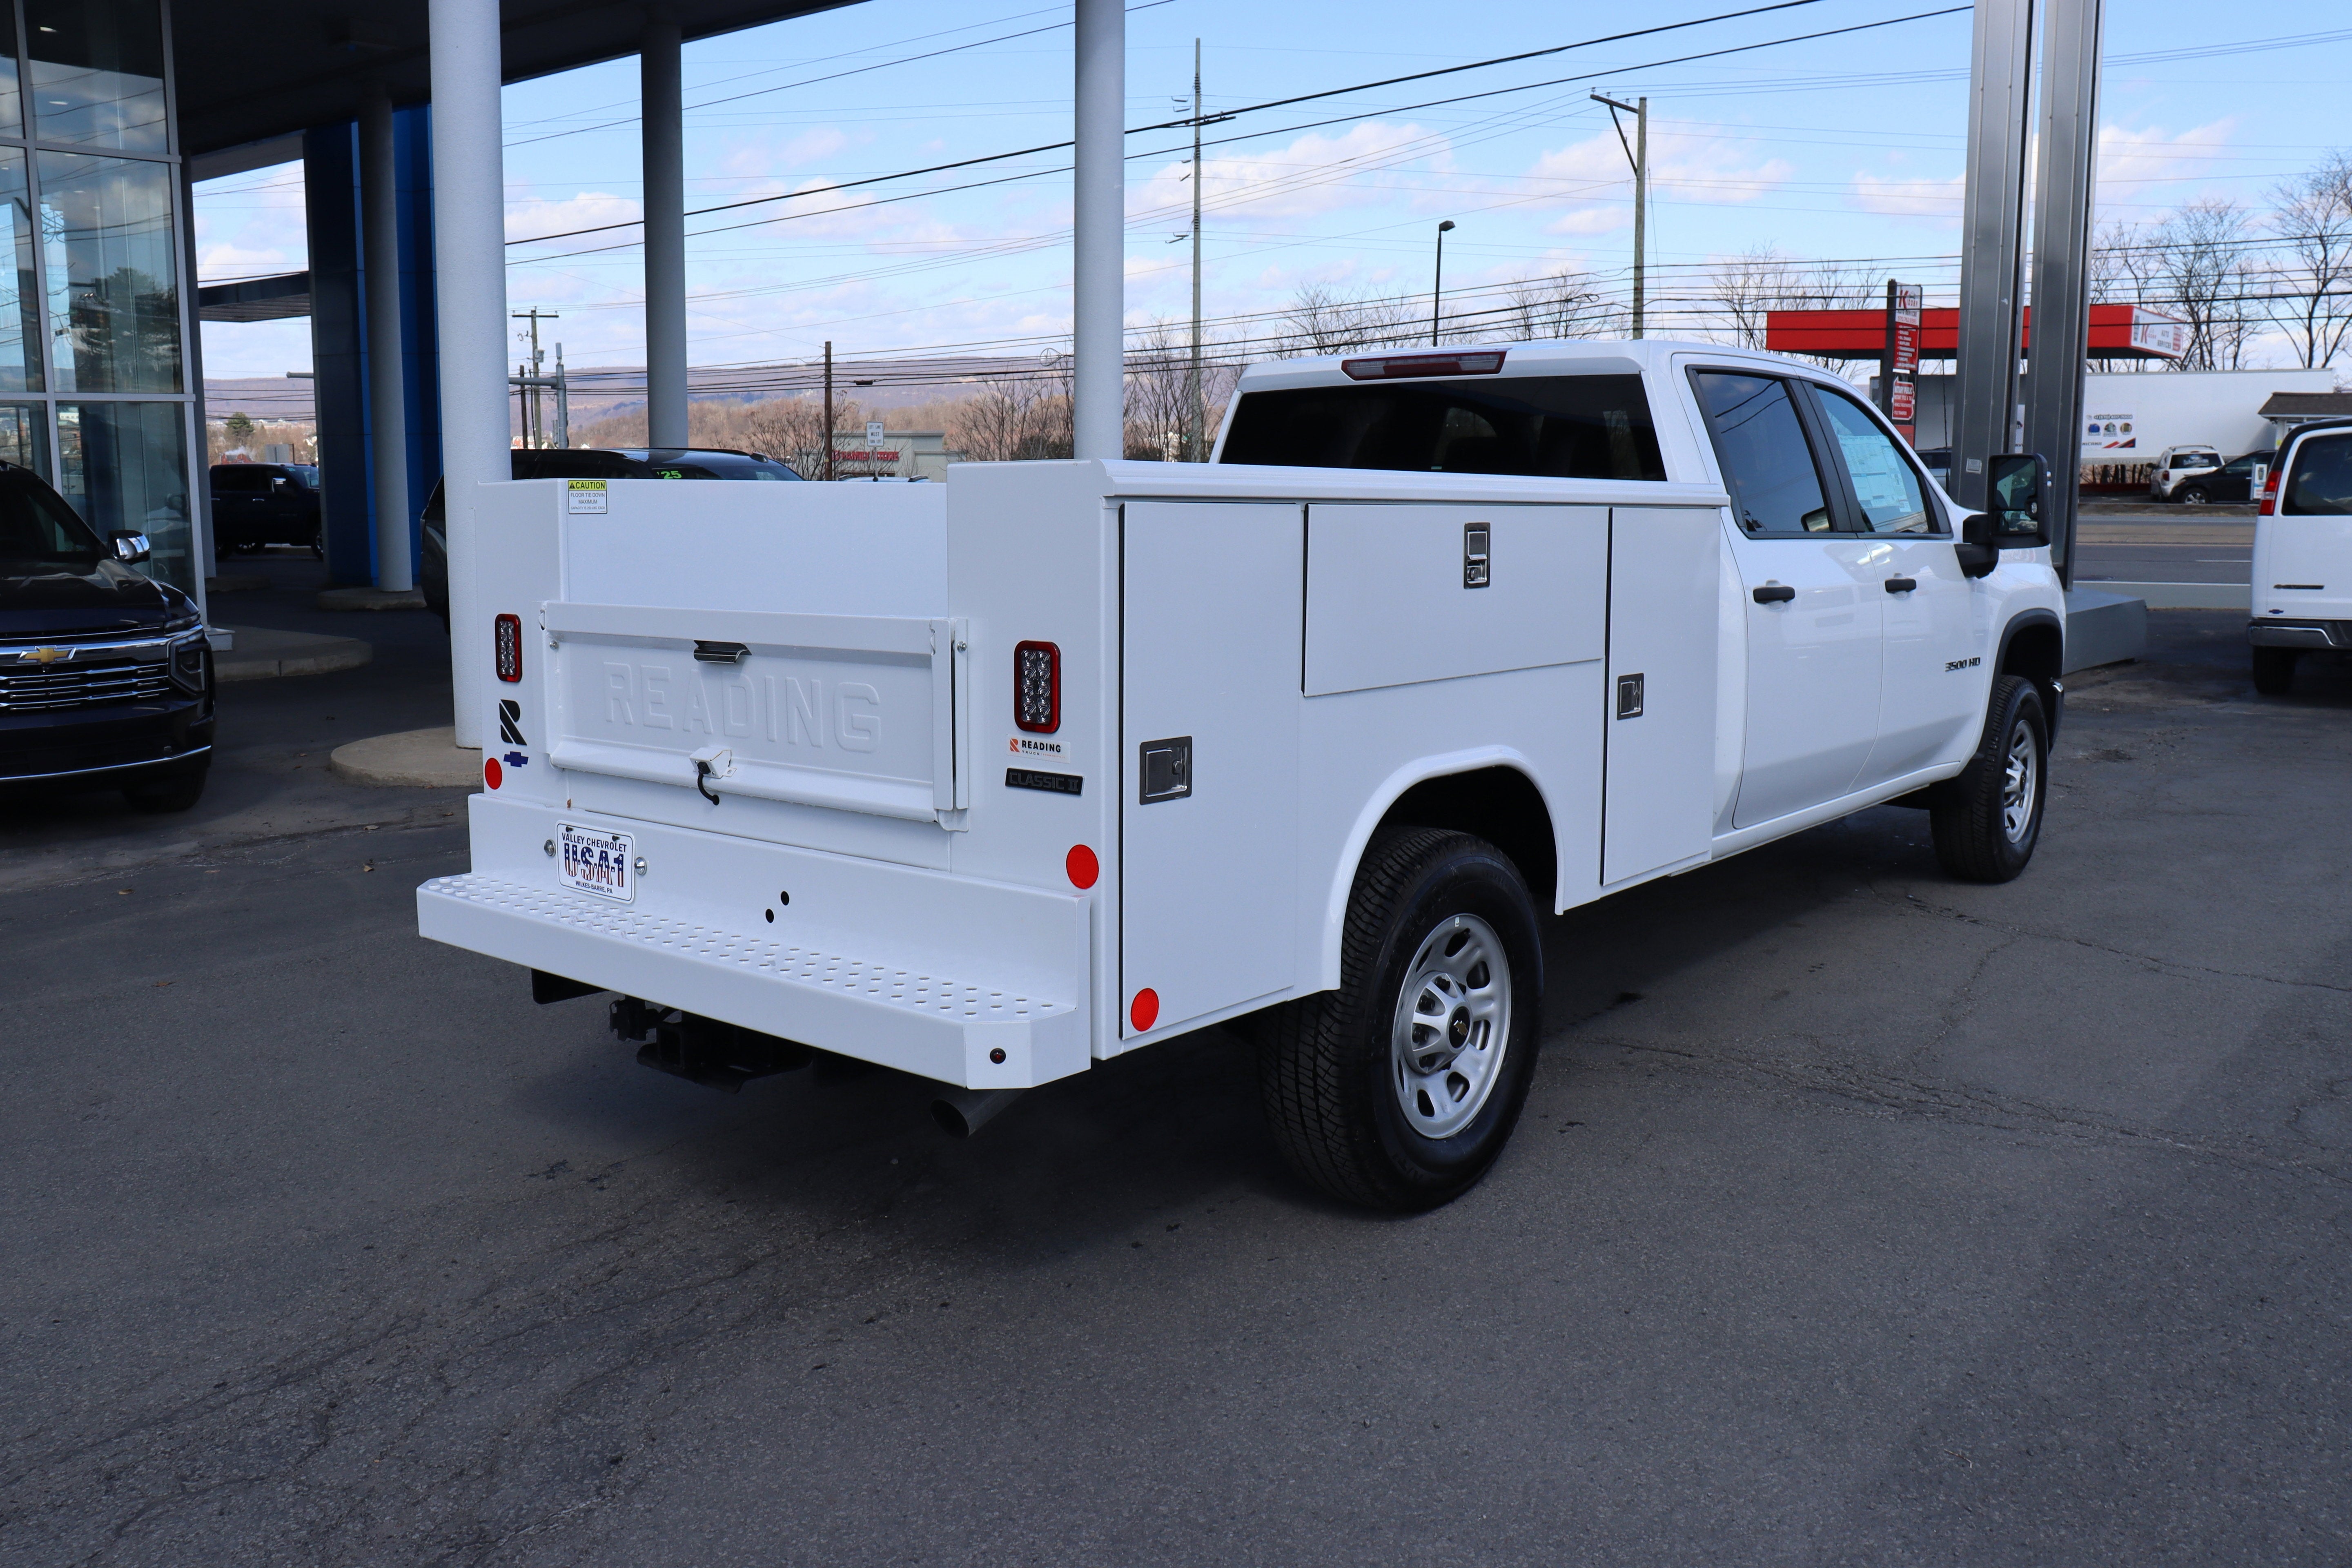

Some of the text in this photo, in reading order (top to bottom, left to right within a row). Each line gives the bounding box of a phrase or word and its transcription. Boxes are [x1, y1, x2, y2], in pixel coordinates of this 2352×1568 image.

[841, 451, 870, 460] FAMILY
[1945, 657, 1980, 672] 3500 HD
[603, 661, 882, 754] READING
[1022, 739, 1061, 753] READING
[1009, 772, 1078, 792] CLASSIC II
[561, 832, 627, 853] VALLEY CHEVROLET
[575, 880, 606, 893] WILKES-BARRE,
